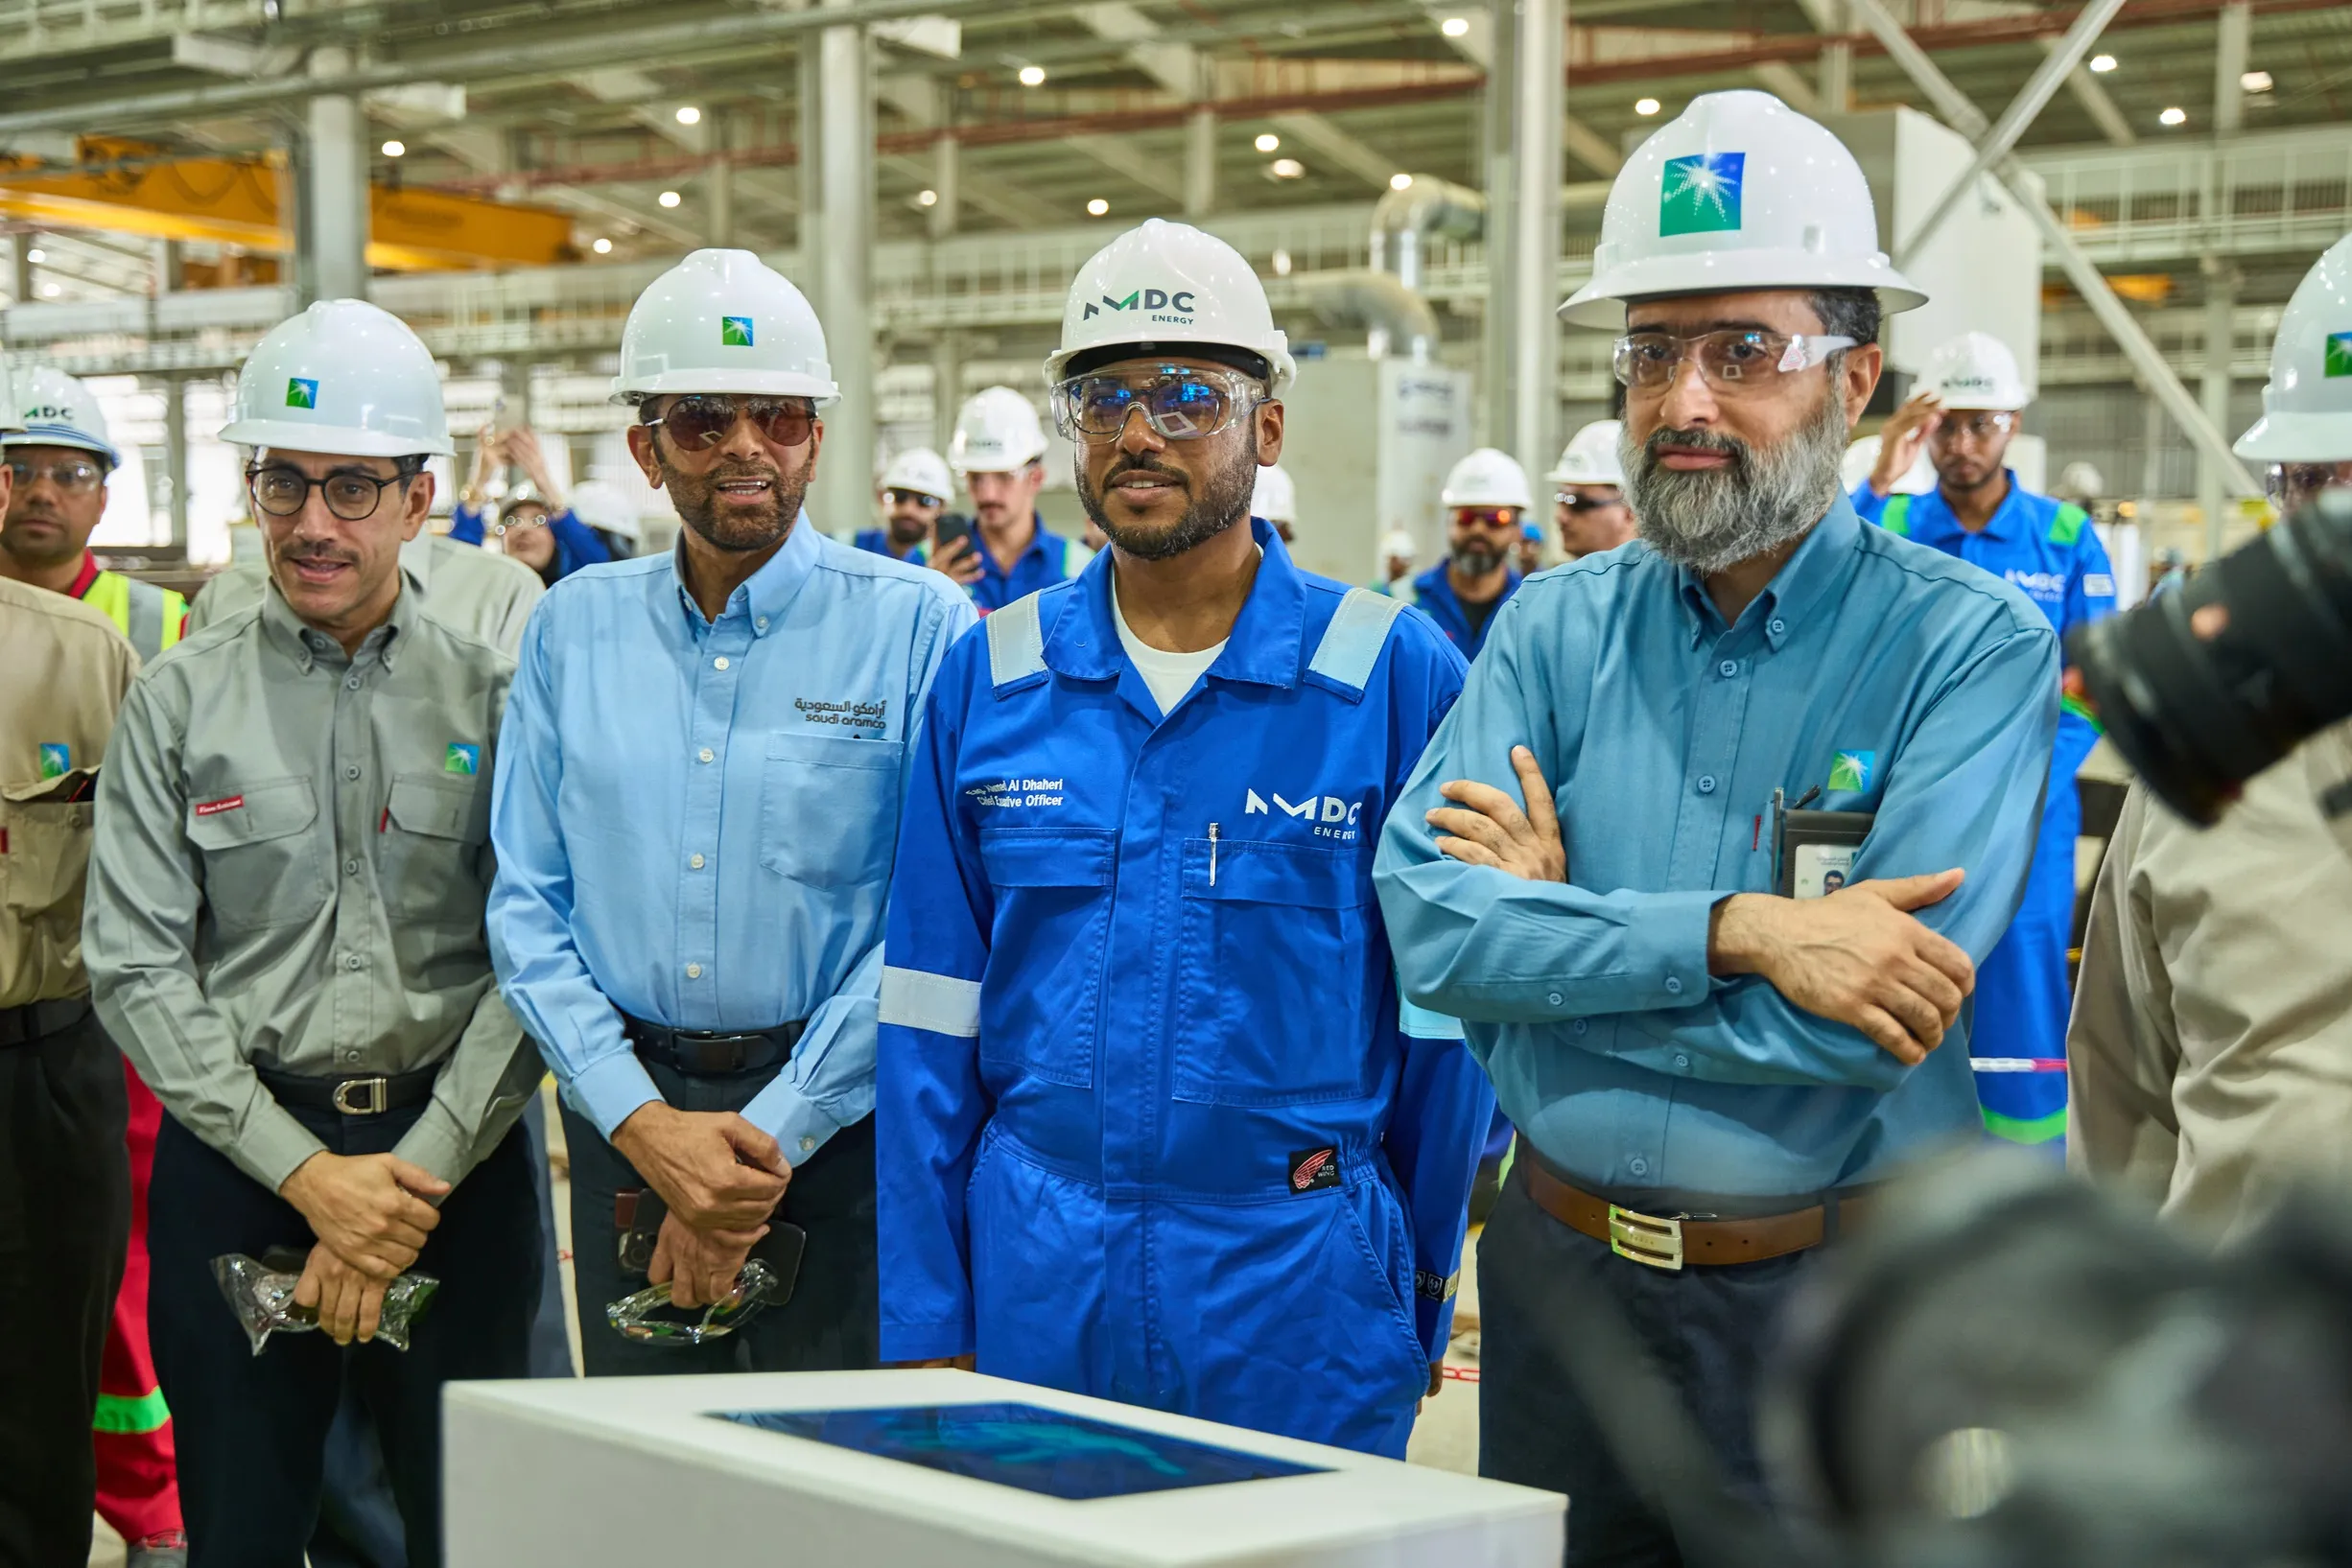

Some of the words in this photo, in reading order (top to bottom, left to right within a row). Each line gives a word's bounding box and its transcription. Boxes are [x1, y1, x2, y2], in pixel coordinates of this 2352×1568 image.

[1152, 315, 1194, 325] ENERGY
[794, 697, 851, 713] السعودية
[853, 700, 887, 718] أرامكو
[806, 714, 839, 724] saudi
[841, 716, 886, 729] aramco
[1007, 779, 1020, 792] Al
[1023, 779, 1064, 791] Dhaheri
[1025, 794, 1064, 807] Officer
[1313, 826, 1355, 840] ENERGY
